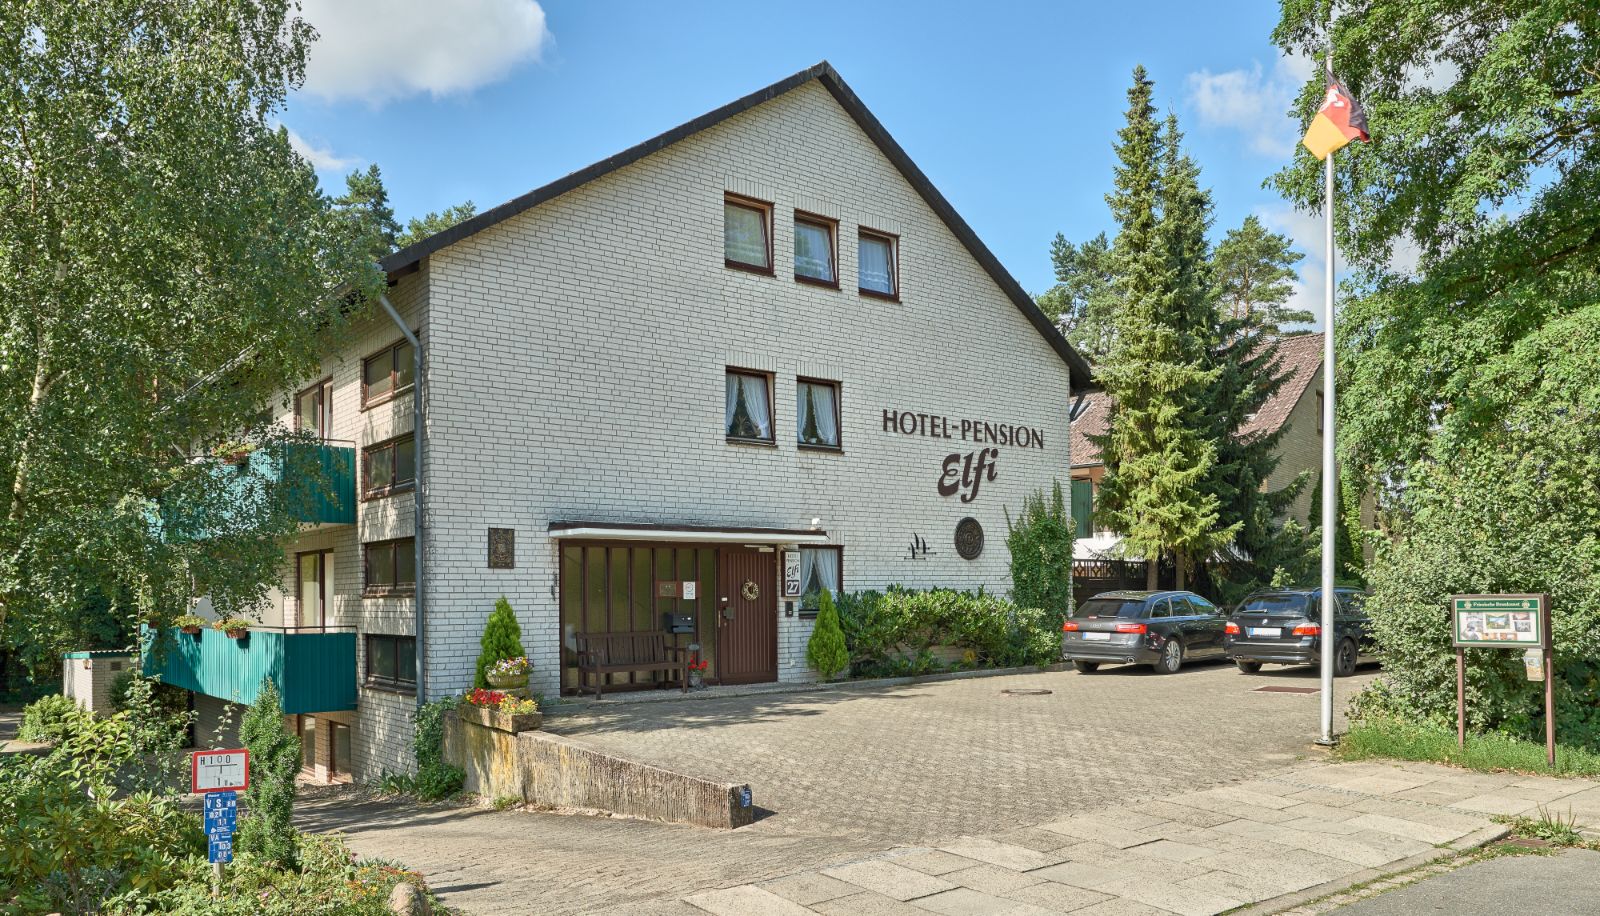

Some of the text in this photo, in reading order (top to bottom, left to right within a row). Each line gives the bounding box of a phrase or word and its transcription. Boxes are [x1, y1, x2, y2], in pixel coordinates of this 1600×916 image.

[882, 409, 1044, 449] HOTEL-PENSION
[937, 447, 999, 503] Elfi
[787, 581, 799, 594] 27
